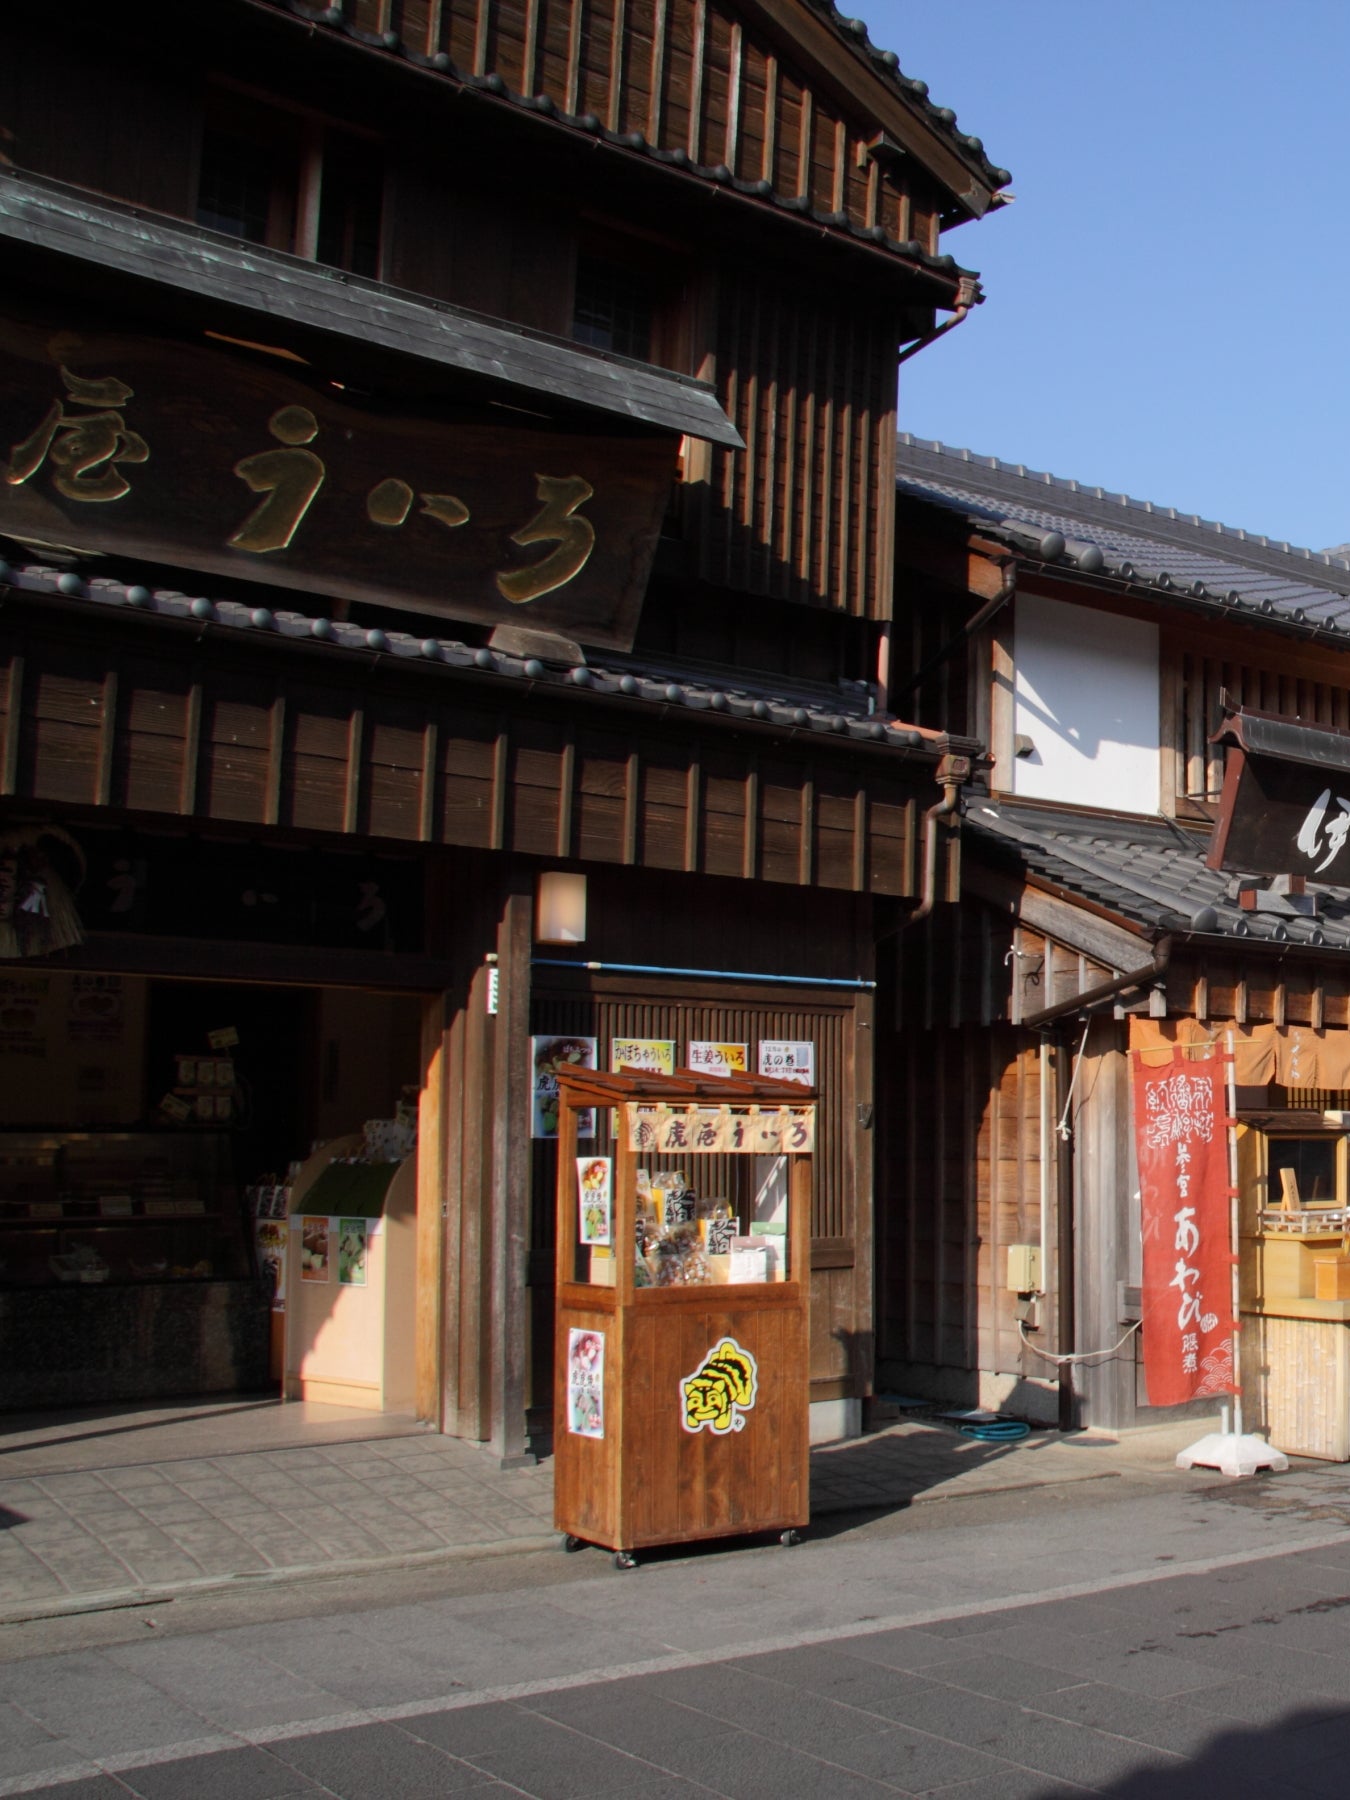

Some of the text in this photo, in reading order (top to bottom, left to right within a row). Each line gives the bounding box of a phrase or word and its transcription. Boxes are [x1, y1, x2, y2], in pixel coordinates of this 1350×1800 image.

[614, 1044, 673, 1062] かぼちゃういろ
[691, 1048, 745, 1066] 生姜ういろ
[762, 1053, 795, 1067] 虎の巻
[664, 1120, 808, 1148] 虎屋ういろ
